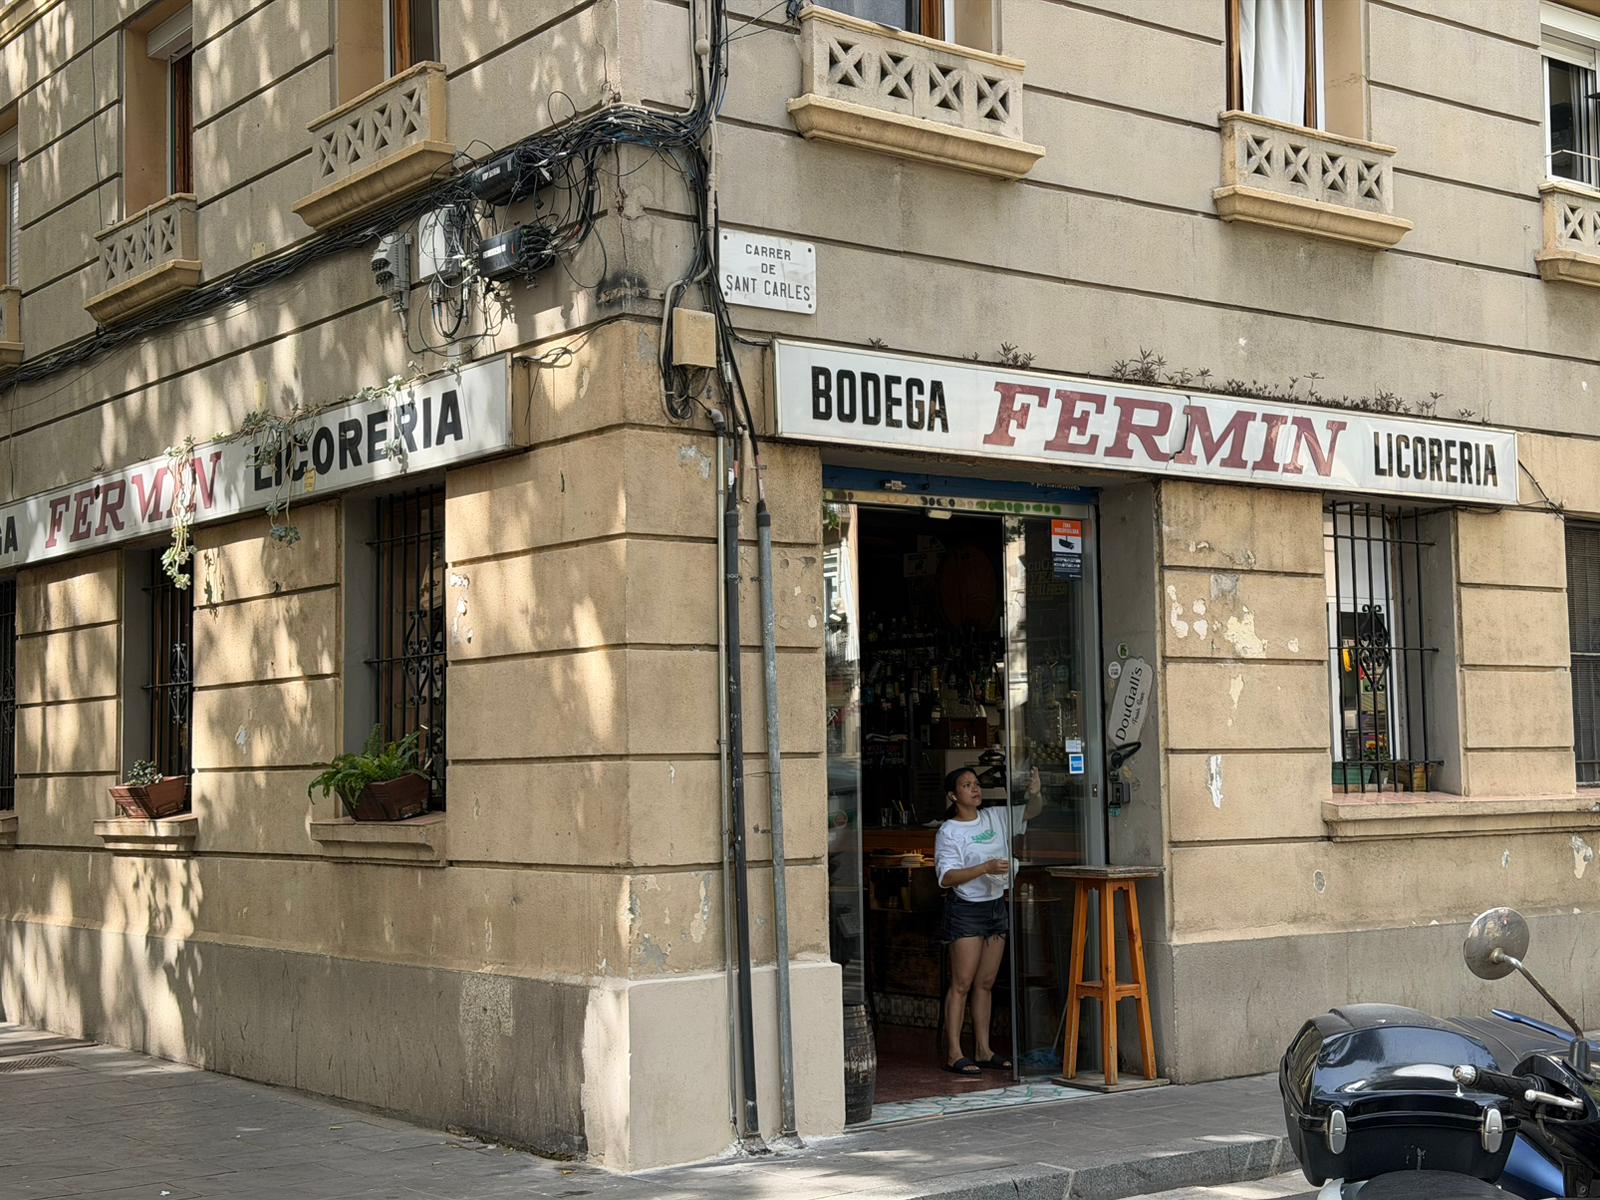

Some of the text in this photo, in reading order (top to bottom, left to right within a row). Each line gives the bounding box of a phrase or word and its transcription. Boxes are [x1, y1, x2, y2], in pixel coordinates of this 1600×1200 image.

[745, 243, 792, 261] CARRER
[761, 263, 776, 275] DE
[726, 274, 810, 302] SANT CARLES
[254, 389, 463, 491] LICORERIA
[811, 365, 1498, 487] BODEGA FERMIN LICORERIA
[1115, 666, 1143, 741] DouGall's
